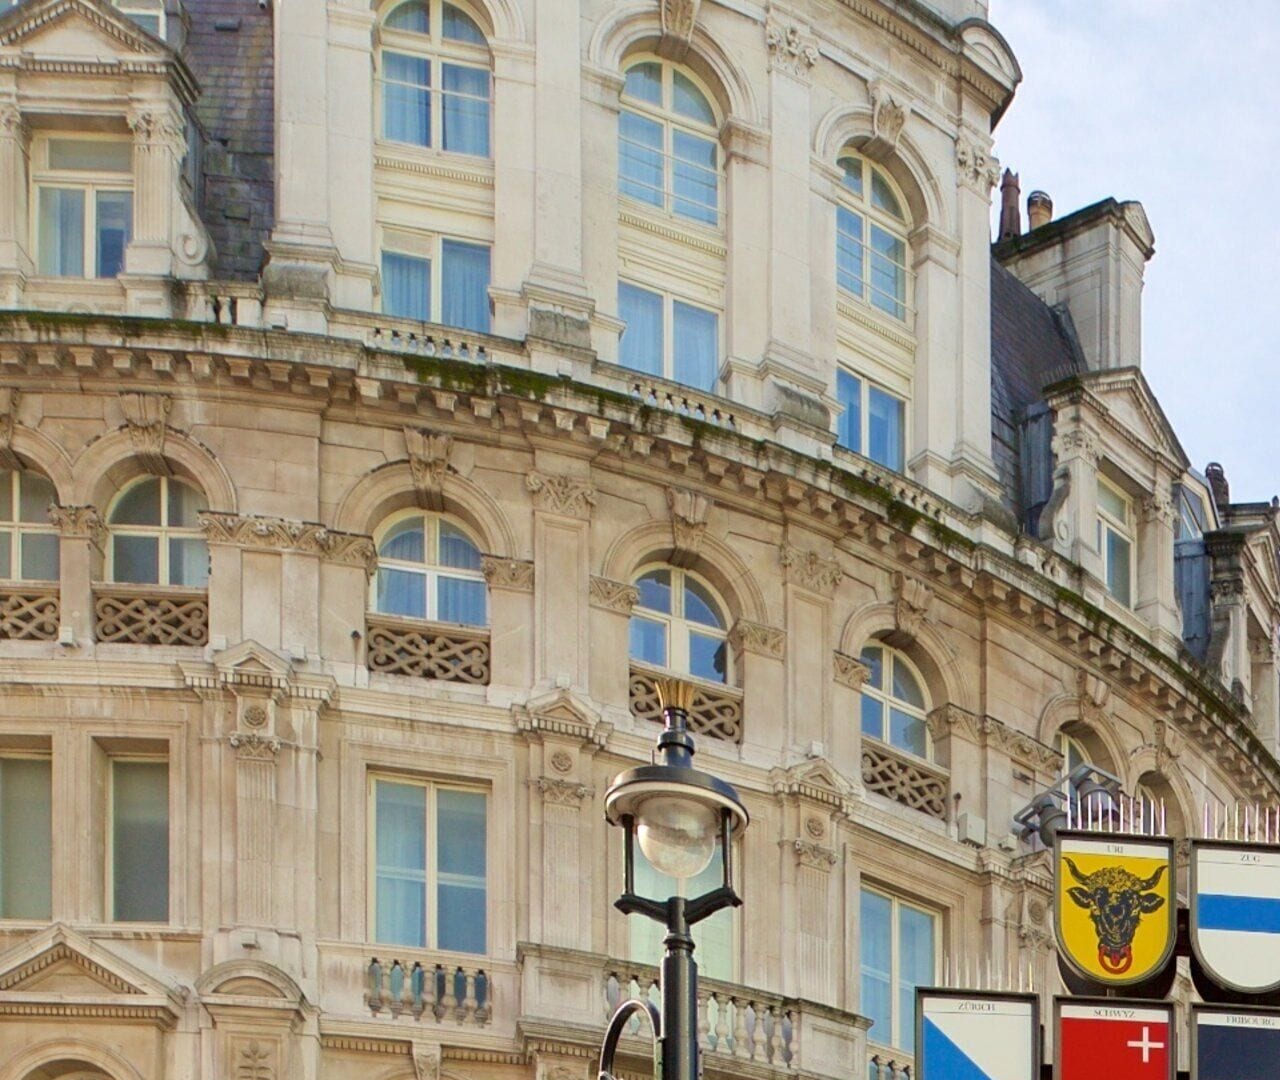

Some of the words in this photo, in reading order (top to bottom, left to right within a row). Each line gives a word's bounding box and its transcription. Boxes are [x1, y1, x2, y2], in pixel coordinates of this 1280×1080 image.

[1106, 845, 1124, 854] URI
[1239, 852, 1261, 863] ZUG
[957, 1000, 996, 1012] ZÜRICH
[1092, 1007, 1136, 1019] SCHWYZ
[1225, 1015, 1276, 1027] FRIBOURG
